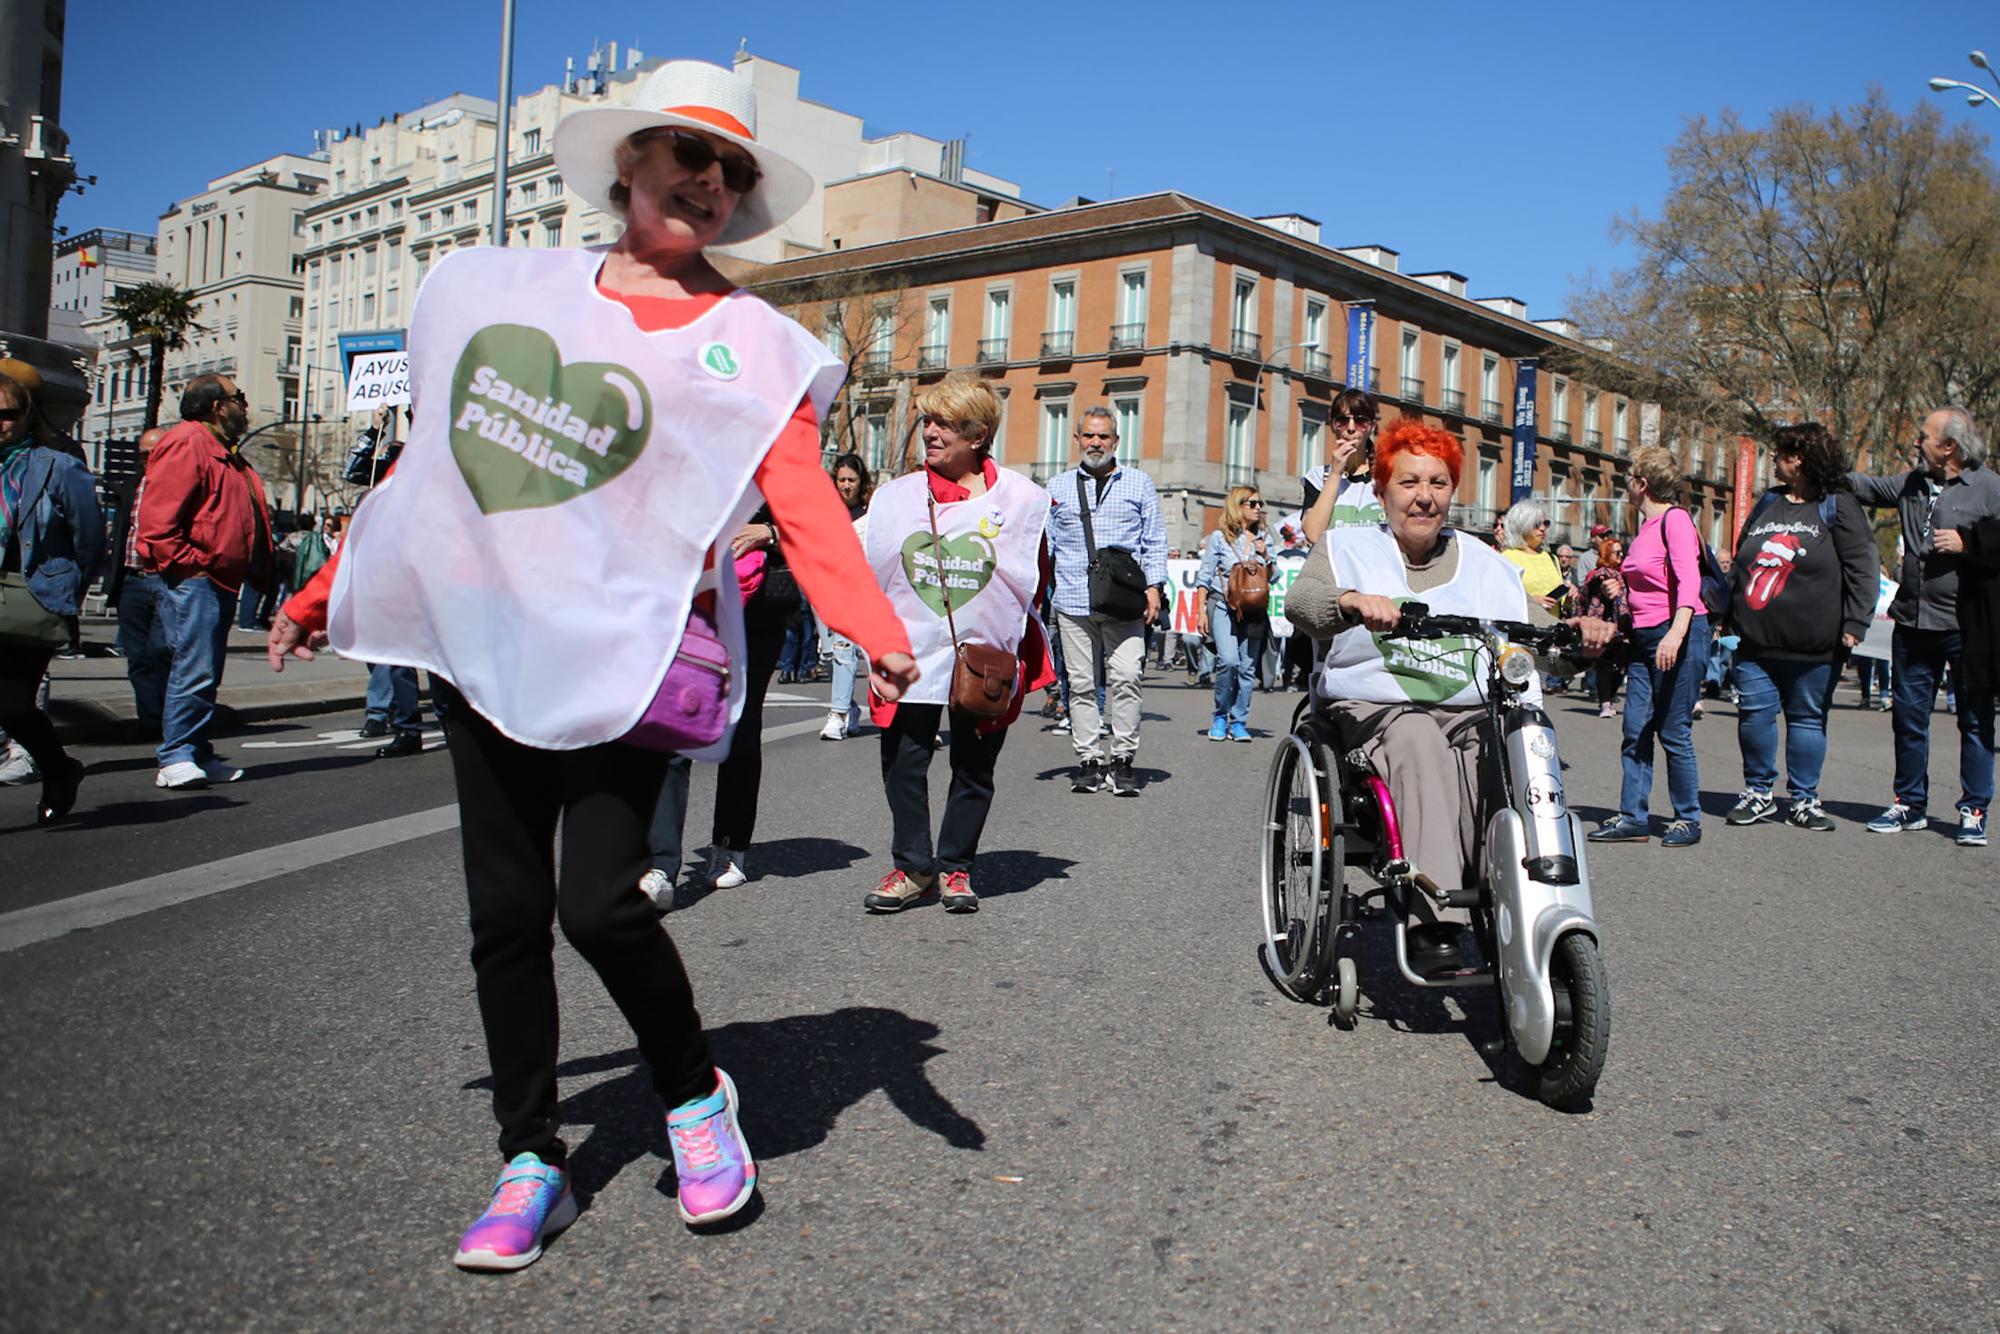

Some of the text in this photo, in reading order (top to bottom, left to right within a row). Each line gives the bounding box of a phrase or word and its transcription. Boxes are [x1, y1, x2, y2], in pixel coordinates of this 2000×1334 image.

[455, 401, 588, 487] Pública
[468, 366, 617, 457] Sanidad
[1514, 475, 1524, 487] De
